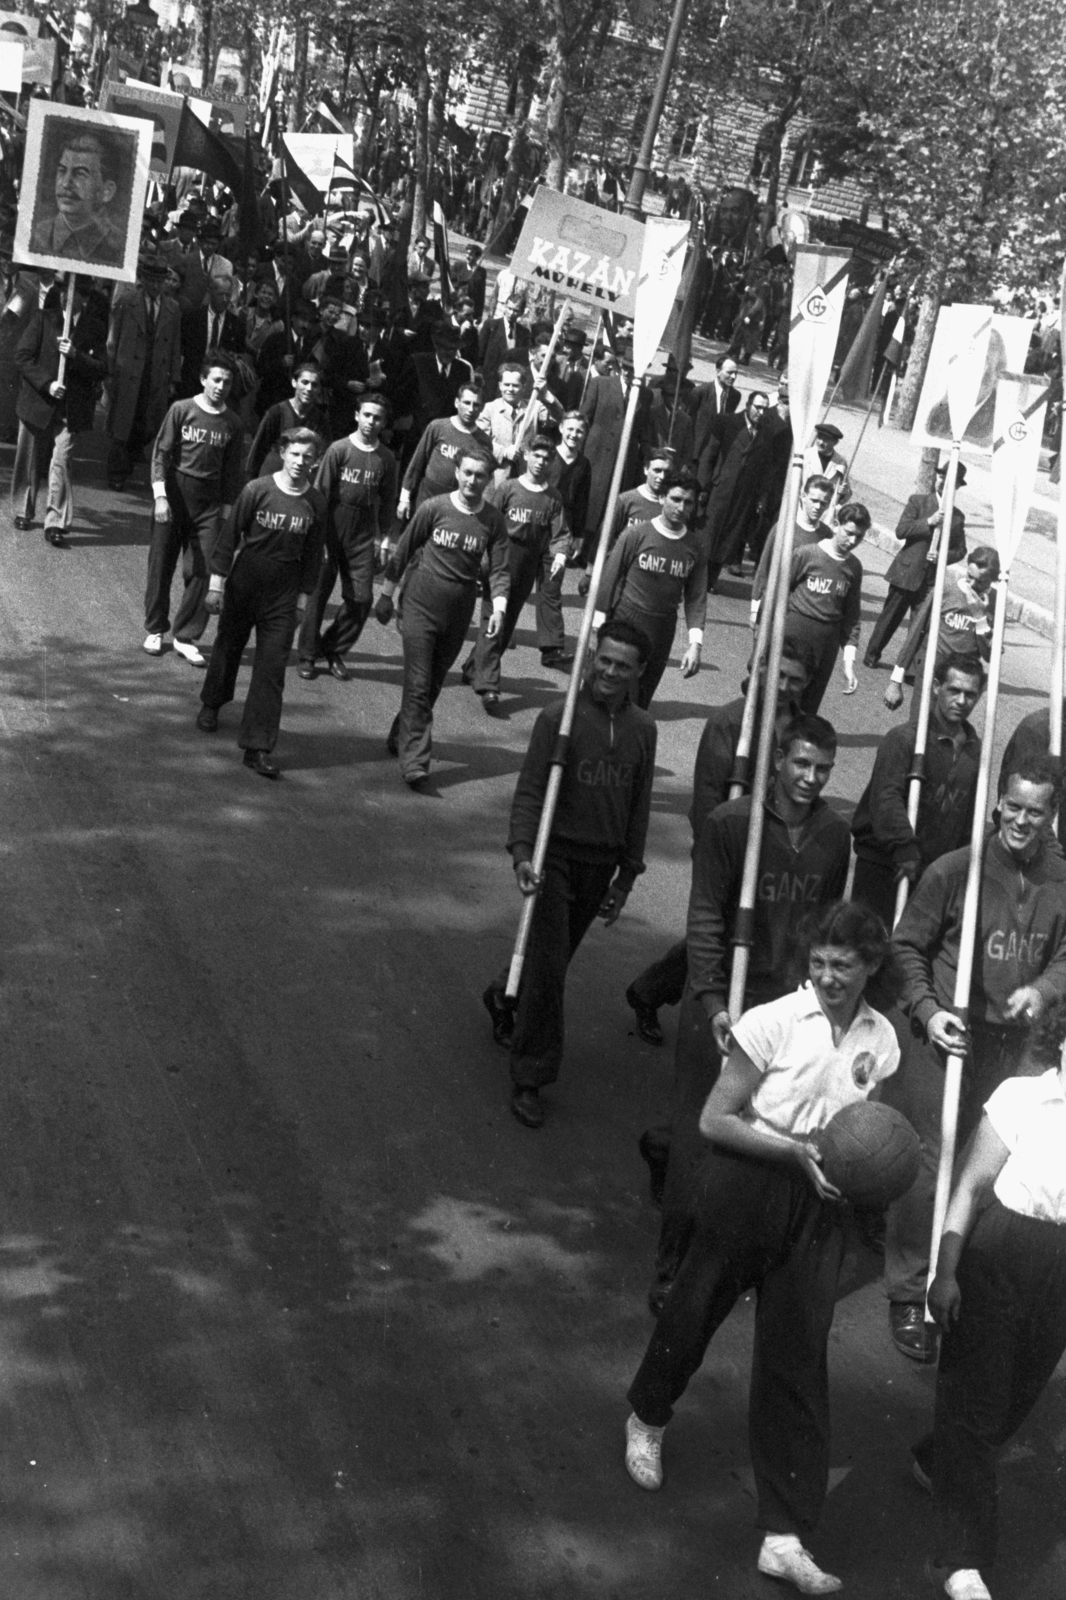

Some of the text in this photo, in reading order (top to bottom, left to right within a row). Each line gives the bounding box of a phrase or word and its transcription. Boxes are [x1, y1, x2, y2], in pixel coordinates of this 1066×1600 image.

[527, 236, 636, 296] KAZÁN
[181, 425, 207, 443] GANZ
[256, 510, 286, 530] GANZ
[508, 507, 532, 523] GANZ
[433, 528, 460, 548] GANZ
[638, 553, 667, 573] GANZ
[807, 576, 833, 594] GANZ
[945, 612, 970, 631] GANZ
[577, 759, 633, 788] GANZ
[758, 871, 822, 903] GANZ
[987, 929, 1049, 966] GANZ
